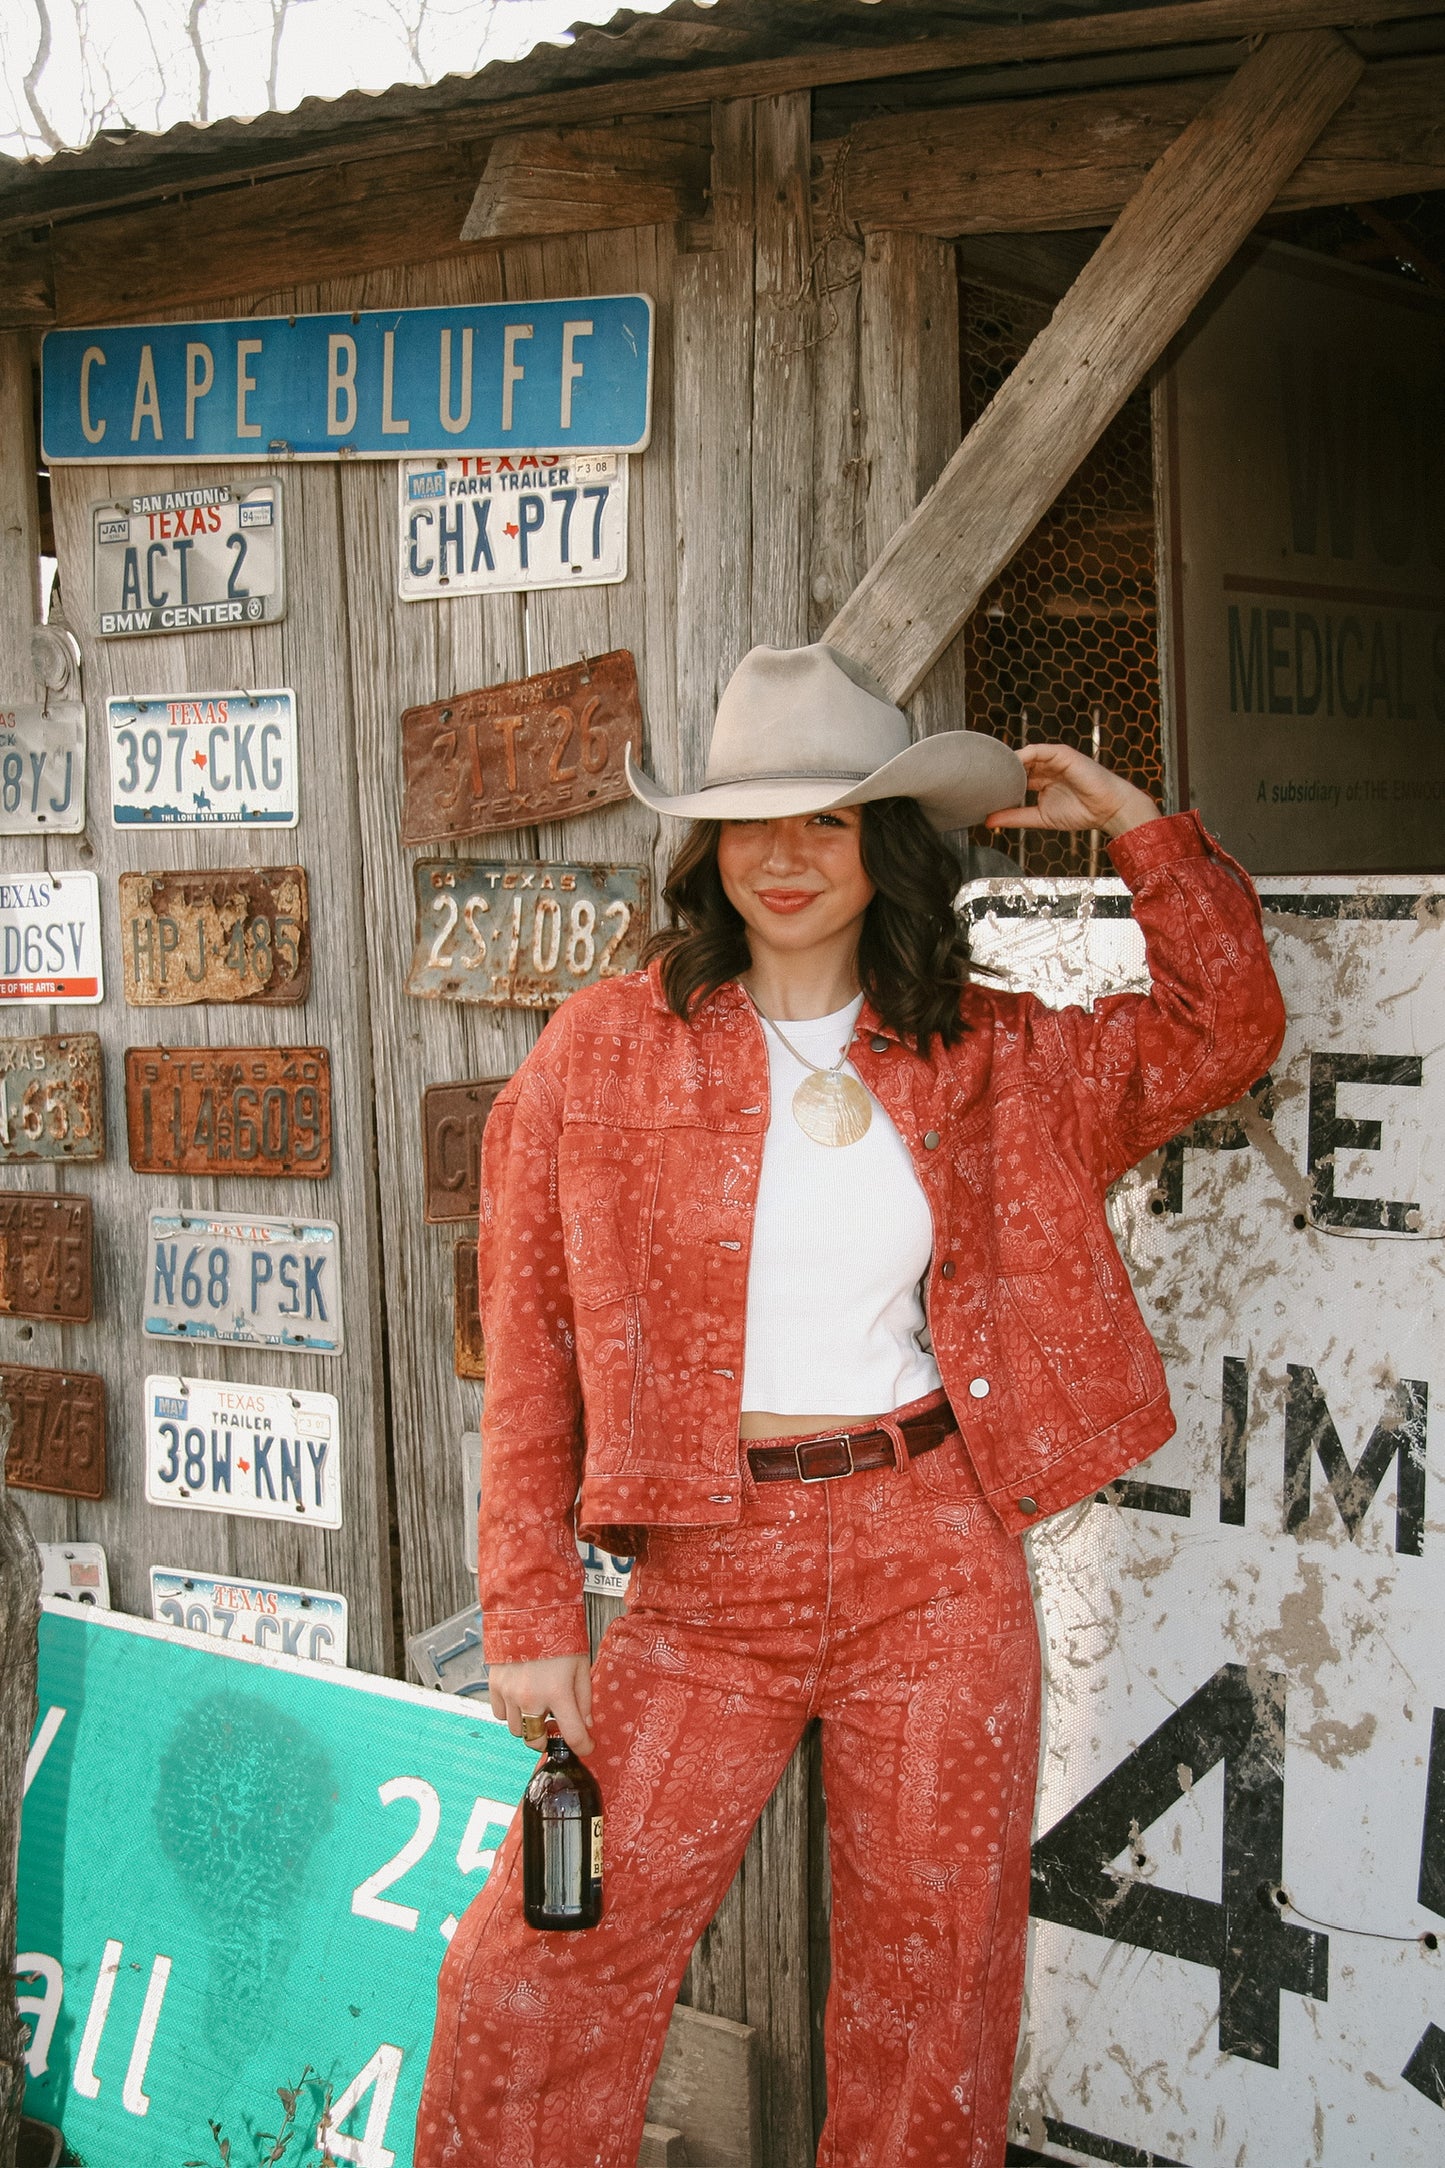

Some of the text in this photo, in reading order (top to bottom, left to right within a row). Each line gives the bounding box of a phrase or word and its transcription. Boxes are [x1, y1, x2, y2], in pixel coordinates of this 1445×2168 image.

[80, 320, 594, 444] CAPE BLUFF
[457, 455, 560, 477] TEXAS
[595, 462, 607, 472] 08
[412, 475, 443, 495] MAR
[449, 468, 569, 496] FARM TRAILER
[132, 486, 231, 514] SAN ANTONIO
[102, 524, 126, 535] JAN
[145, 505, 222, 540] TEXAS
[242, 510, 254, 523] 94
[409, 486, 609, 577] CHX P77
[122, 533, 249, 610] ACT 2
[102, 603, 243, 633] BMW CENTER
[1228, 605, 1418, 721] MEDICAL
[167, 701, 229, 726] TEXAS
[116, 724, 283, 794] 397 CKG
[3, 751, 72, 812] 8YJ
[1256, 780, 1267, 802] A
[1271, 780, 1341, 808] subsidiary
[1364, 780, 1388, 801] THE
[471, 785, 574, 819] TEXAS
[160, 813, 242, 822] THE LONE STAR STATE
[485, 872, 577, 891] TEXAS
[4, 922, 85, 975] D6SV
[508, 896, 631, 977] 1082
[8, 984, 18, 994] OF
[19, 983, 34, 993] THE
[36, 982, 55, 992] ARTS
[173, 1061, 268, 1082] TEXAS
[232, 1084, 321, 1161] 609
[153, 1242, 327, 1321] N68 PSK
[159, 1398, 185, 1415] MAY
[218, 1393, 265, 1412] TEXAS
[212, 1412, 272, 1431] TRAILER
[158, 1422, 328, 1507] 38W KNY
[594, 1574, 623, 1588] STATE
[213, 1585, 278, 1616] TEXAS
